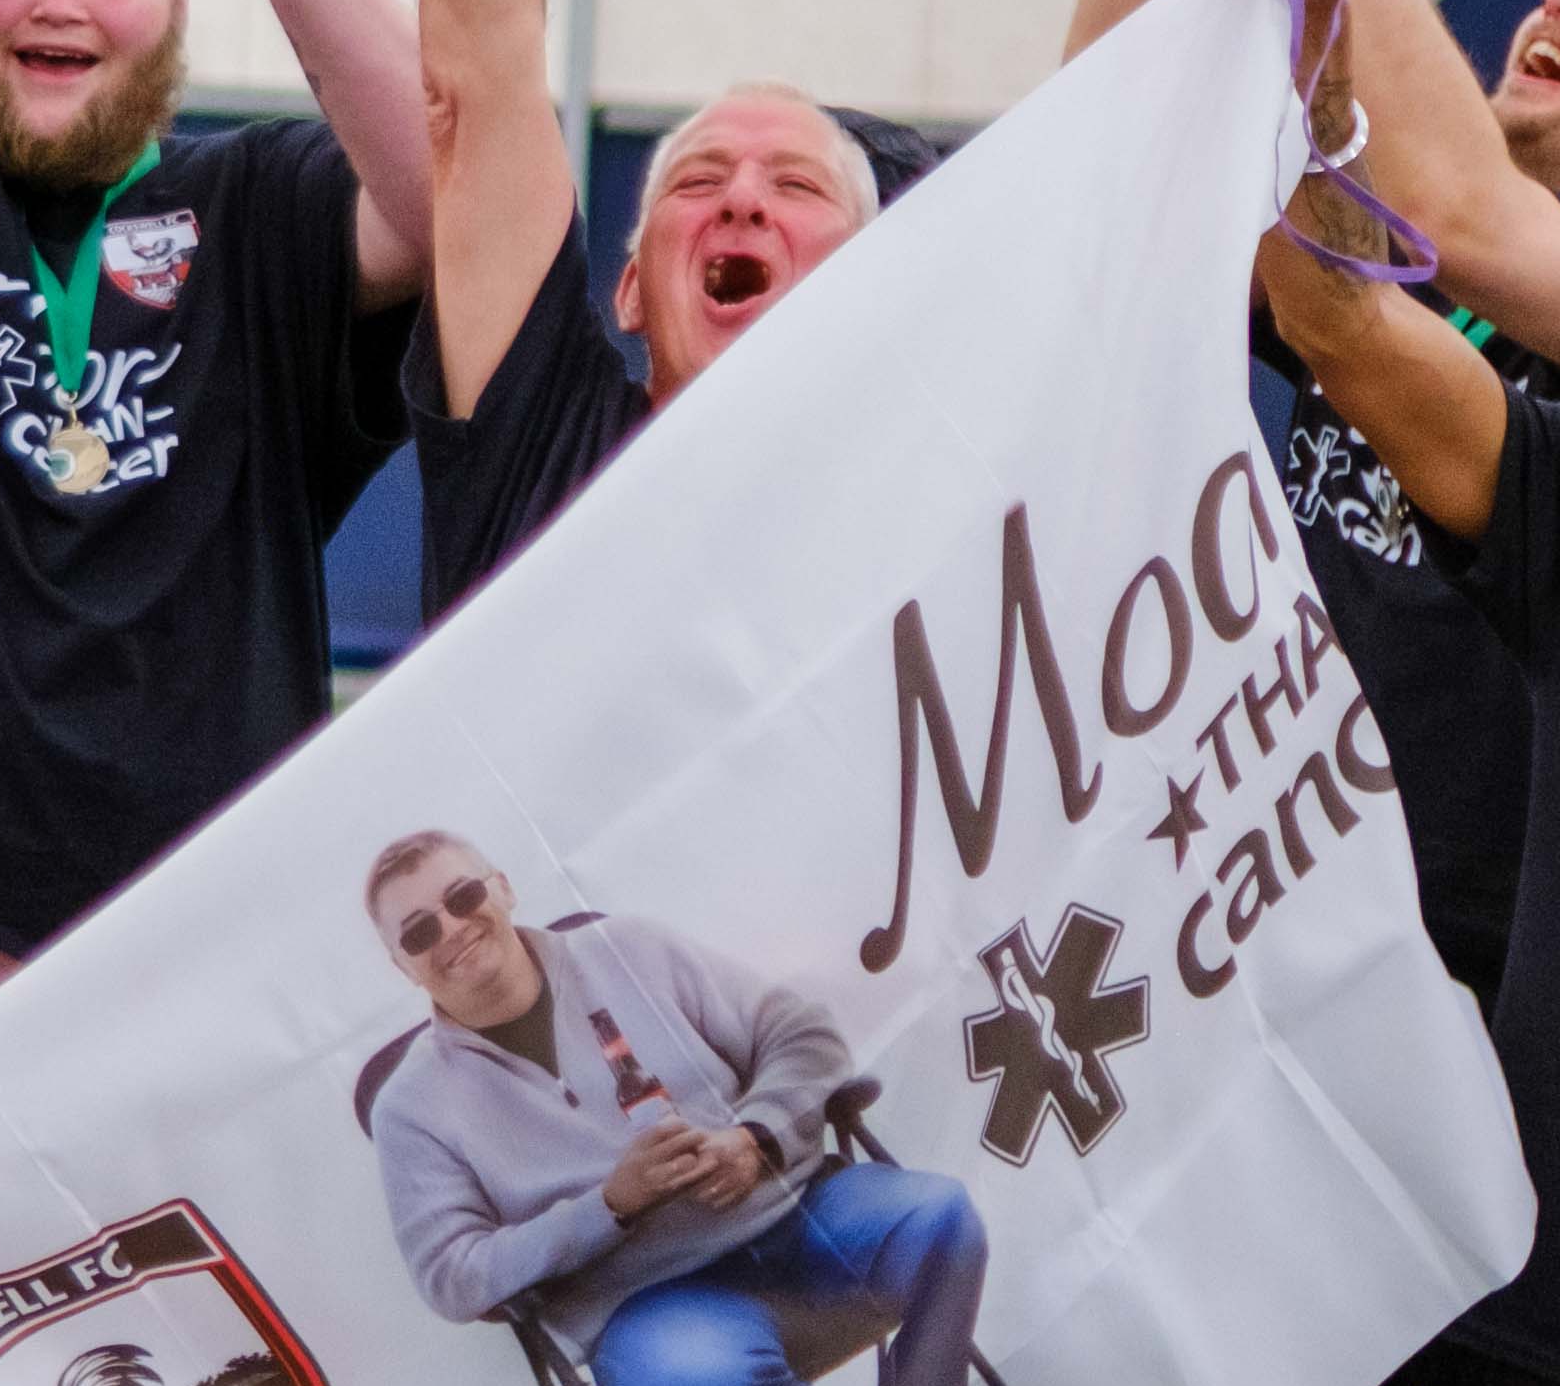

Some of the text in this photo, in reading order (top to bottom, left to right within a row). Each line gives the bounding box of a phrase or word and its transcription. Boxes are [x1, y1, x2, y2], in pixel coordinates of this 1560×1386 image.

[1195, 588, 1347, 795] THA
[1175, 693, 1401, 1000] canc
[70, 1239, 134, 1292] FC
